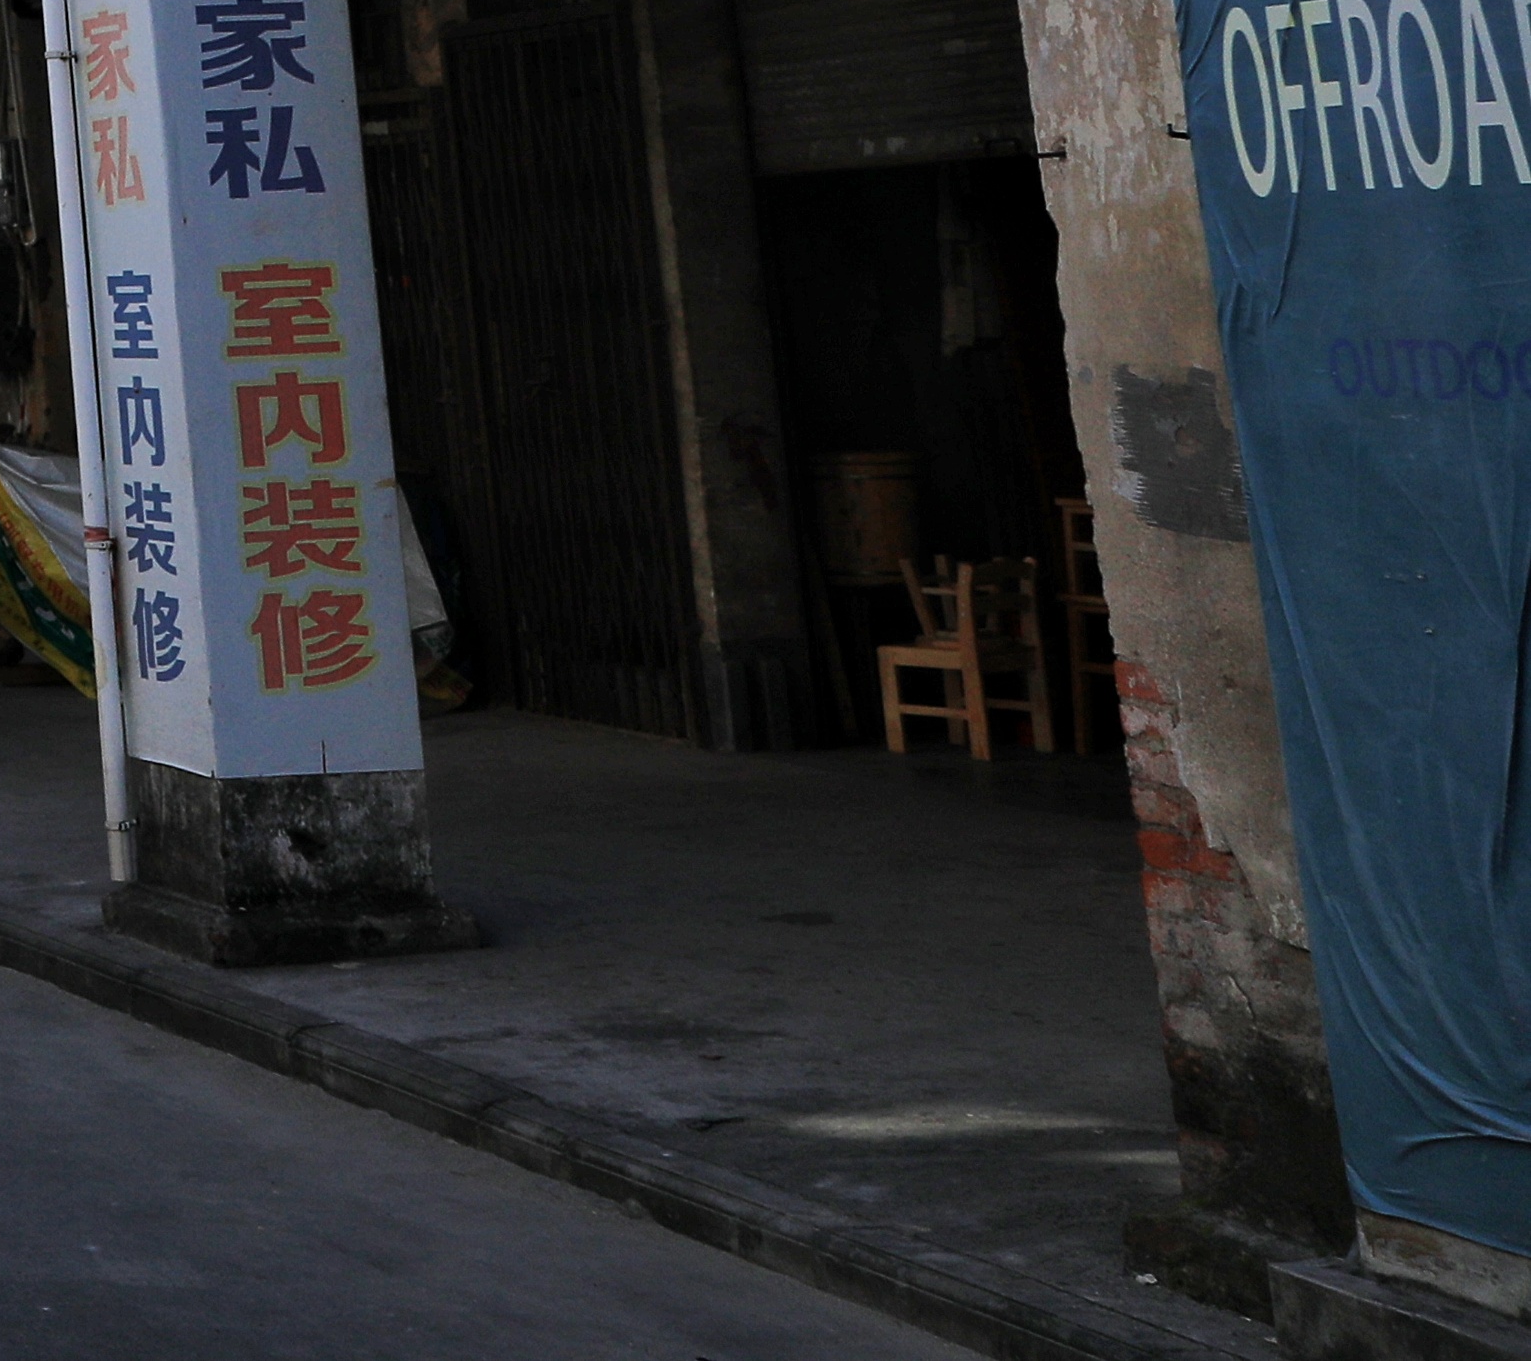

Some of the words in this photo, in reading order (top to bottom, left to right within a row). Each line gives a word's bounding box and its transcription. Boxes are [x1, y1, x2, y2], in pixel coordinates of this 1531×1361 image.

[82, 10, 146, 208] 家私
[107, 270, 186, 682] 室内装修
[220, 262, 375, 692] 室内装修
